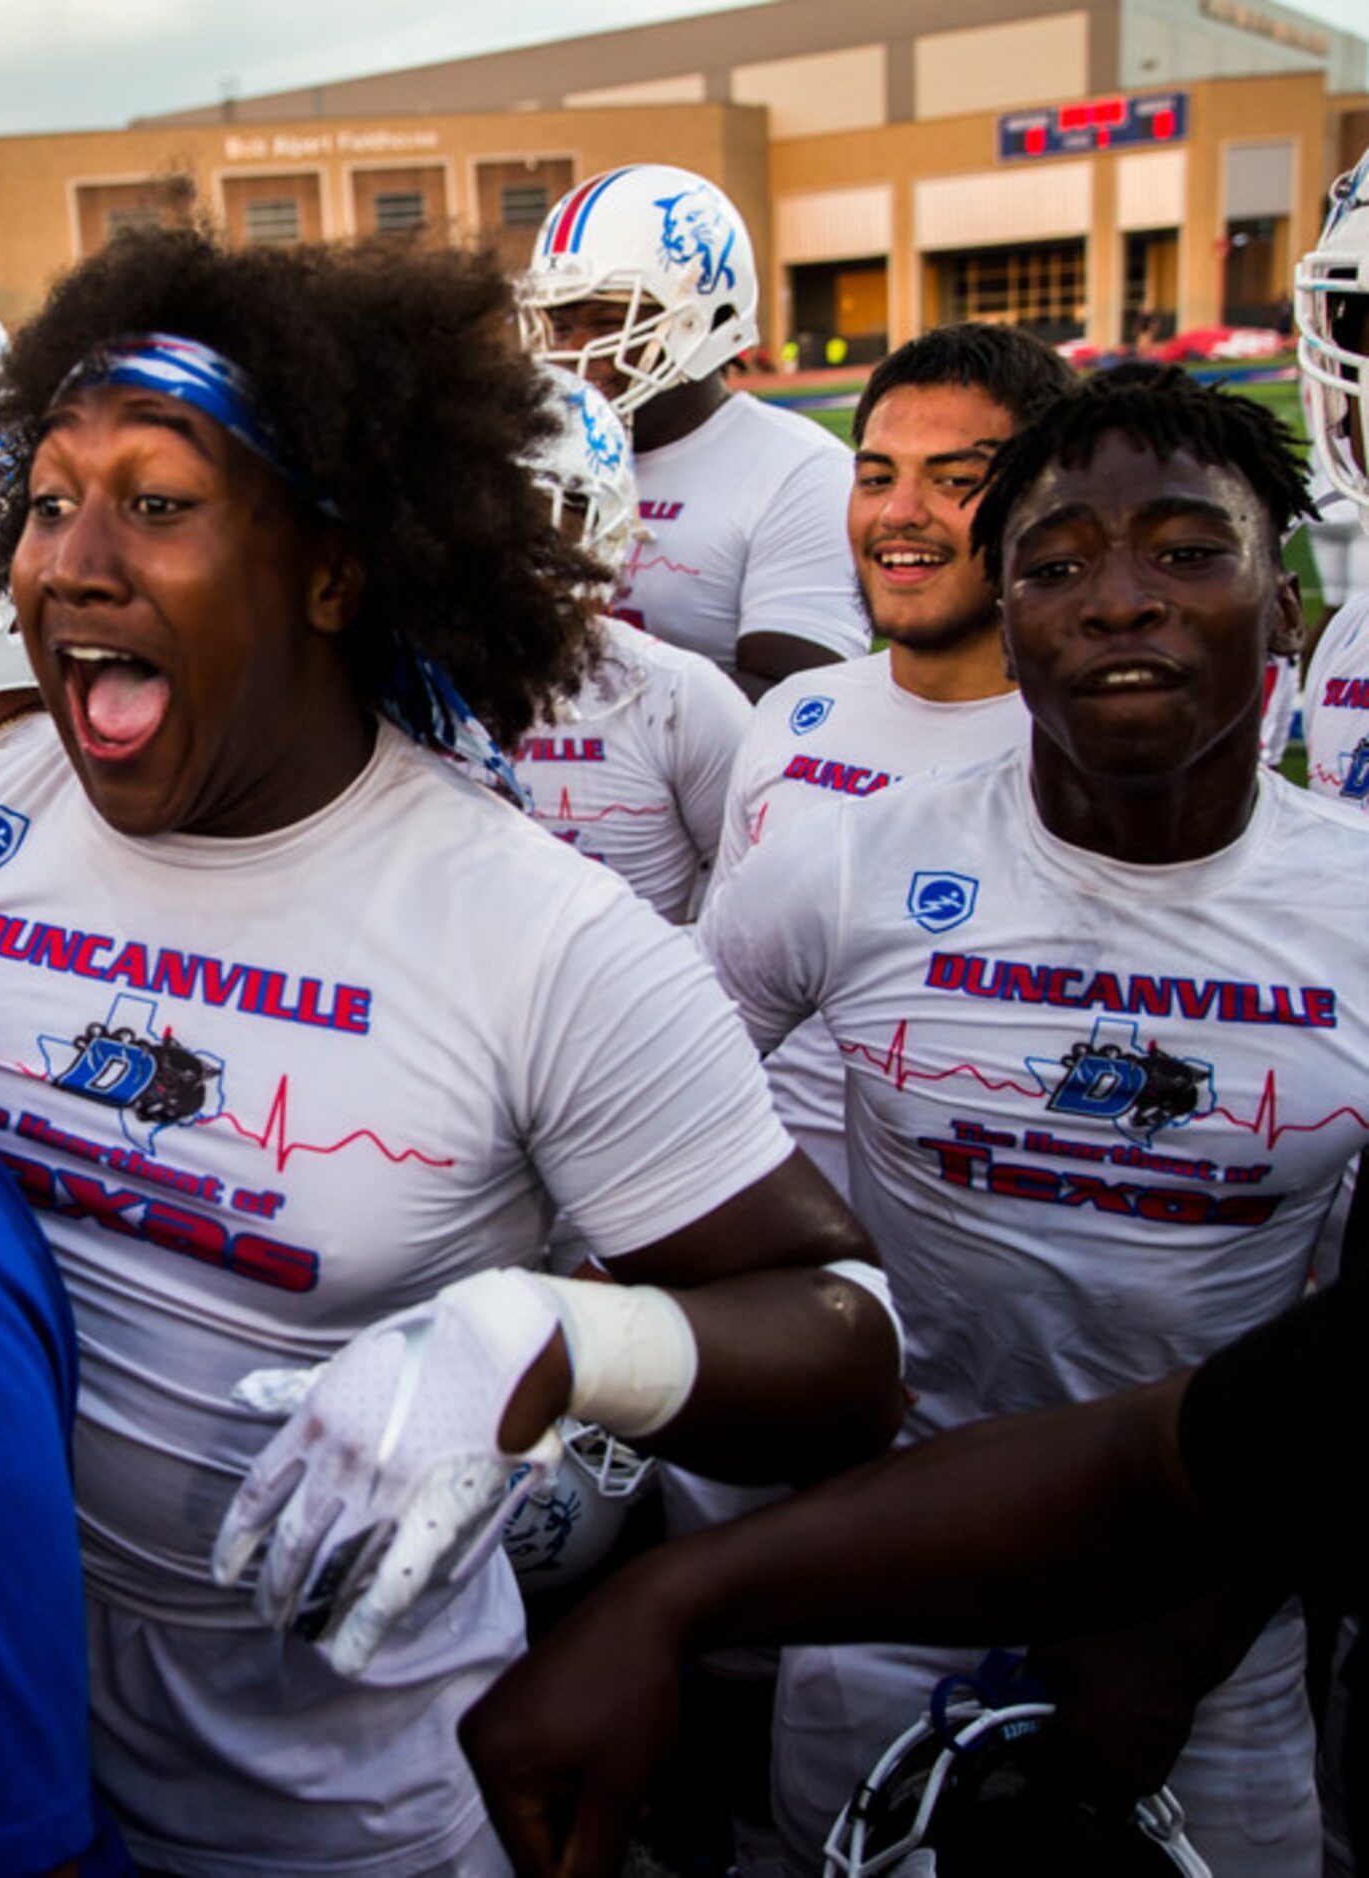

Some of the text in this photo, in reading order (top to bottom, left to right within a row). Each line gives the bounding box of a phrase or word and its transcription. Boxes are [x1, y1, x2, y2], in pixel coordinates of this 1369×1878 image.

[782, 754, 891, 797] DUNCA
[925, 952, 1337, 1028] DUNCANVILLE
[16, 1111, 226, 1203] Heartbeat
[231, 1188, 285, 1219] of
[950, 1119, 1273, 1184] The Heartbeat of
